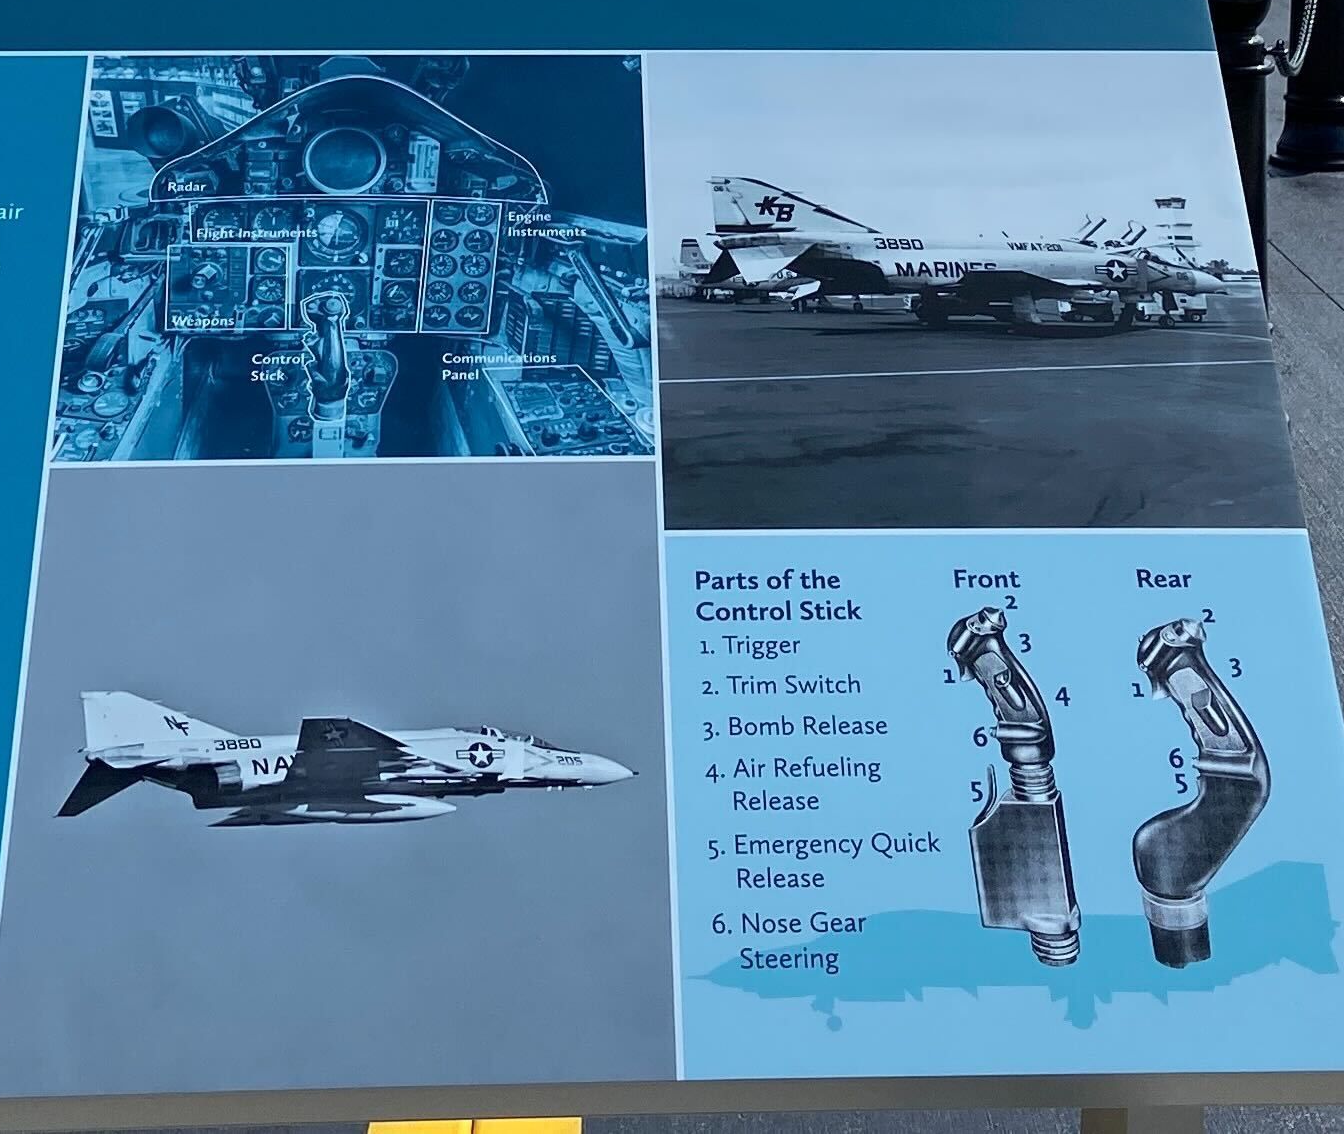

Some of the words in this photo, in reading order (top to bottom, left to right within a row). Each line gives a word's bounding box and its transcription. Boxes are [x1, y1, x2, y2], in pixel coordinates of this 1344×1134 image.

[167, 181, 206, 192] Radar
[508, 211, 551, 224] Engine
[755, 196, 795, 222] KB
[197, 228, 234, 240] Flight
[239, 228, 318, 238] Instruments
[508, 227, 587, 237] Instruments
[172, 315, 234, 328] Weapons
[252, 353, 304, 365] Control
[442, 352, 557, 364] Communications
[250, 369, 285, 381] Stick
[442, 369, 479, 380] Panel
[696, 570, 759, 590] Parts
[766, 568, 795, 590] of
[799, 569, 841, 590] the
[954, 569, 1021, 588] Front
[1136, 568, 1192, 588] Rear
[696, 600, 792, 622] Control
[800, 599, 862, 620] Stick
[700, 640, 715, 654] 1.
[722, 635, 800, 660] Trigger
[702, 680, 719, 695] 2.
[726, 675, 777, 694] Trim
[785, 673, 861, 694] Switch
[703, 722, 720, 742] 3.
[728, 714, 794, 736] Bomb
[803, 714, 888, 736] Release
[705, 763, 726, 784] 4.
[733, 758, 766, 778] Air
[774, 756, 882, 783] Refueling
[733, 789, 819, 811] Release
[708, 840, 726, 860] 5.
[734, 834, 863, 860] Emergency
[871, 831, 941, 859] Quick
[737, 866, 824, 889] Release
[712, 912, 732, 935] 6.
[742, 912, 802, 934] Nose
[810, 911, 867, 933] Gear
[740, 946, 839, 975] Steering
